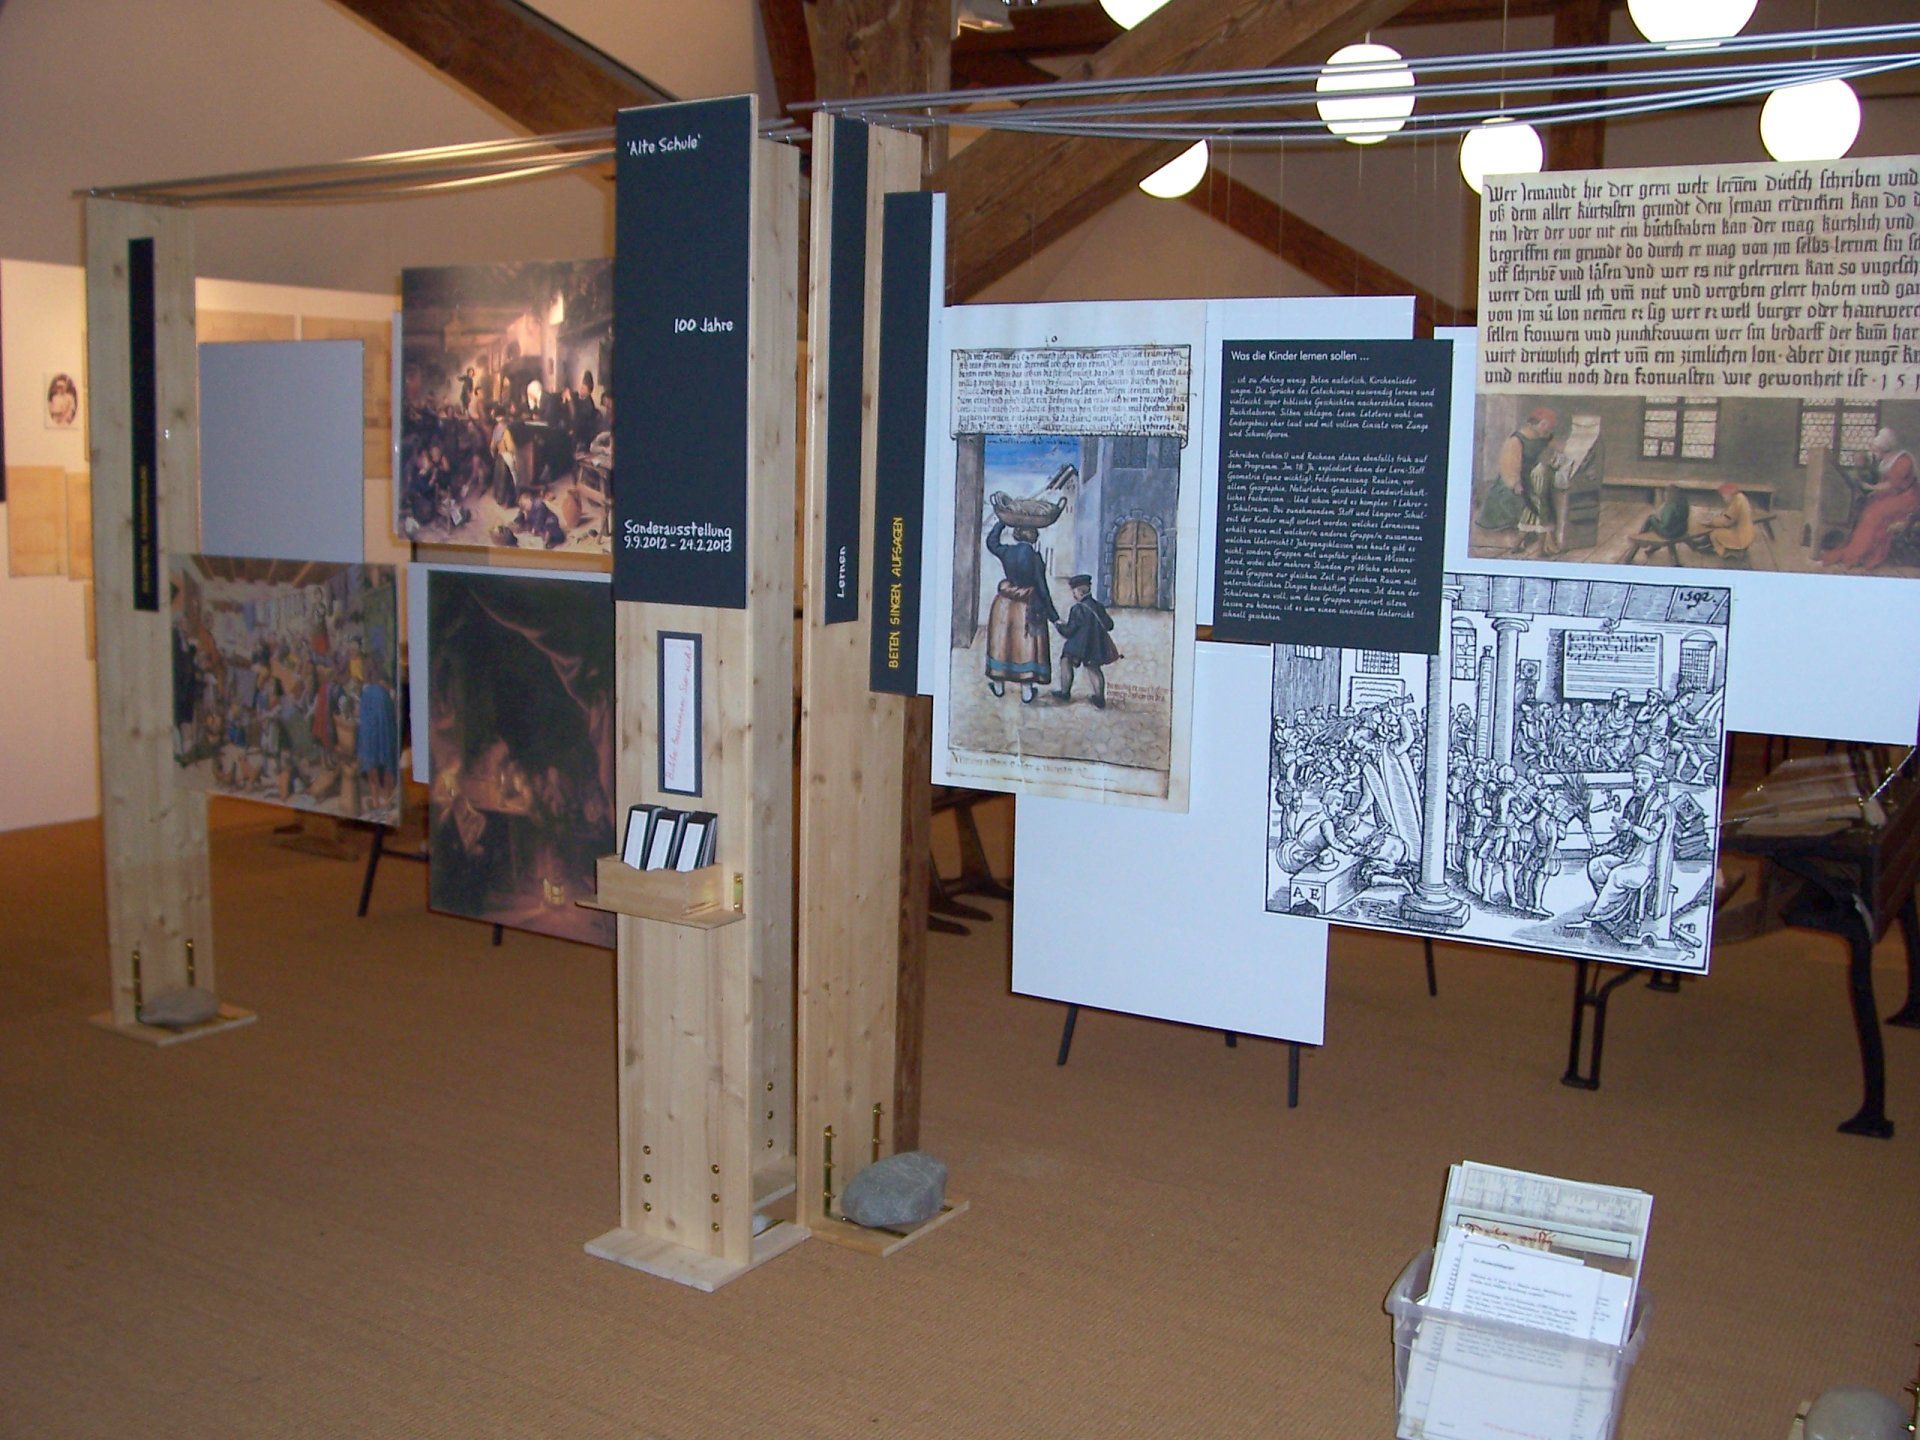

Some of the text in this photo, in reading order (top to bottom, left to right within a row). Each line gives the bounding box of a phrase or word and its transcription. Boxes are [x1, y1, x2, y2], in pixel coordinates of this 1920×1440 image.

[674, 316, 733, 334] 100 Jahre
[1230, 350, 1250, 360] Was
[1252, 350, 1266, 360] die
[1268, 350, 1297, 360] Kinder
[1299, 350, 1327, 360] lernen
[1329, 351, 1357, 360] sollen
[624, 519, 732, 540] Sonderausstellung
[623, 535, 668, 550] 9.9.2012
[679, 538, 733, 553] 24.2.2013
[891, 517, 903, 577] AUFSAGEN
[837, 545, 847, 599] Lernen
[1293, 886, 1320, 901] A E
